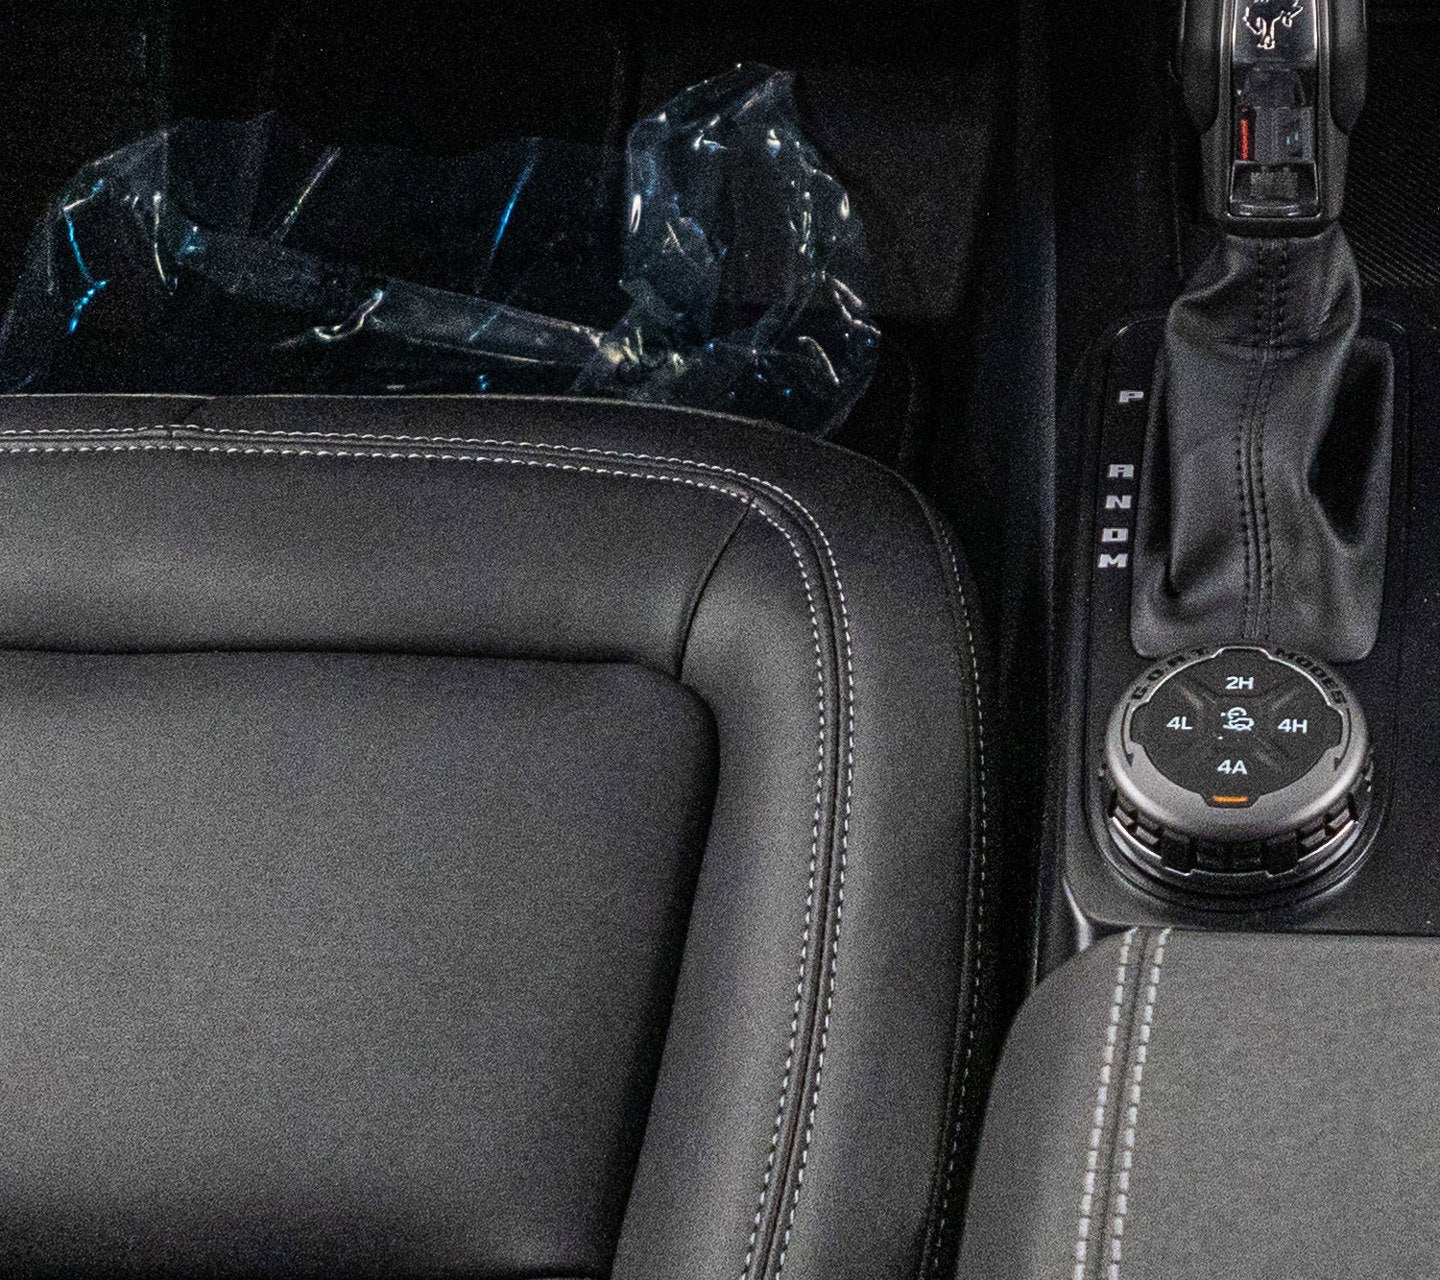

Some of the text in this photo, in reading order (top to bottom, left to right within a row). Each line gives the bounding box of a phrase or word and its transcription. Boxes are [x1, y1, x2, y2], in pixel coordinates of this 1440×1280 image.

[1119, 391, 1144, 403] P
[1105, 495, 1132, 508] N
[1097, 554, 1128, 568] M
[1225, 676, 1254, 690] 2H
[1166, 716, 1193, 730] 4L
[1277, 719, 1308, 733] 4H
[1217, 760, 1248, 775] 4A
